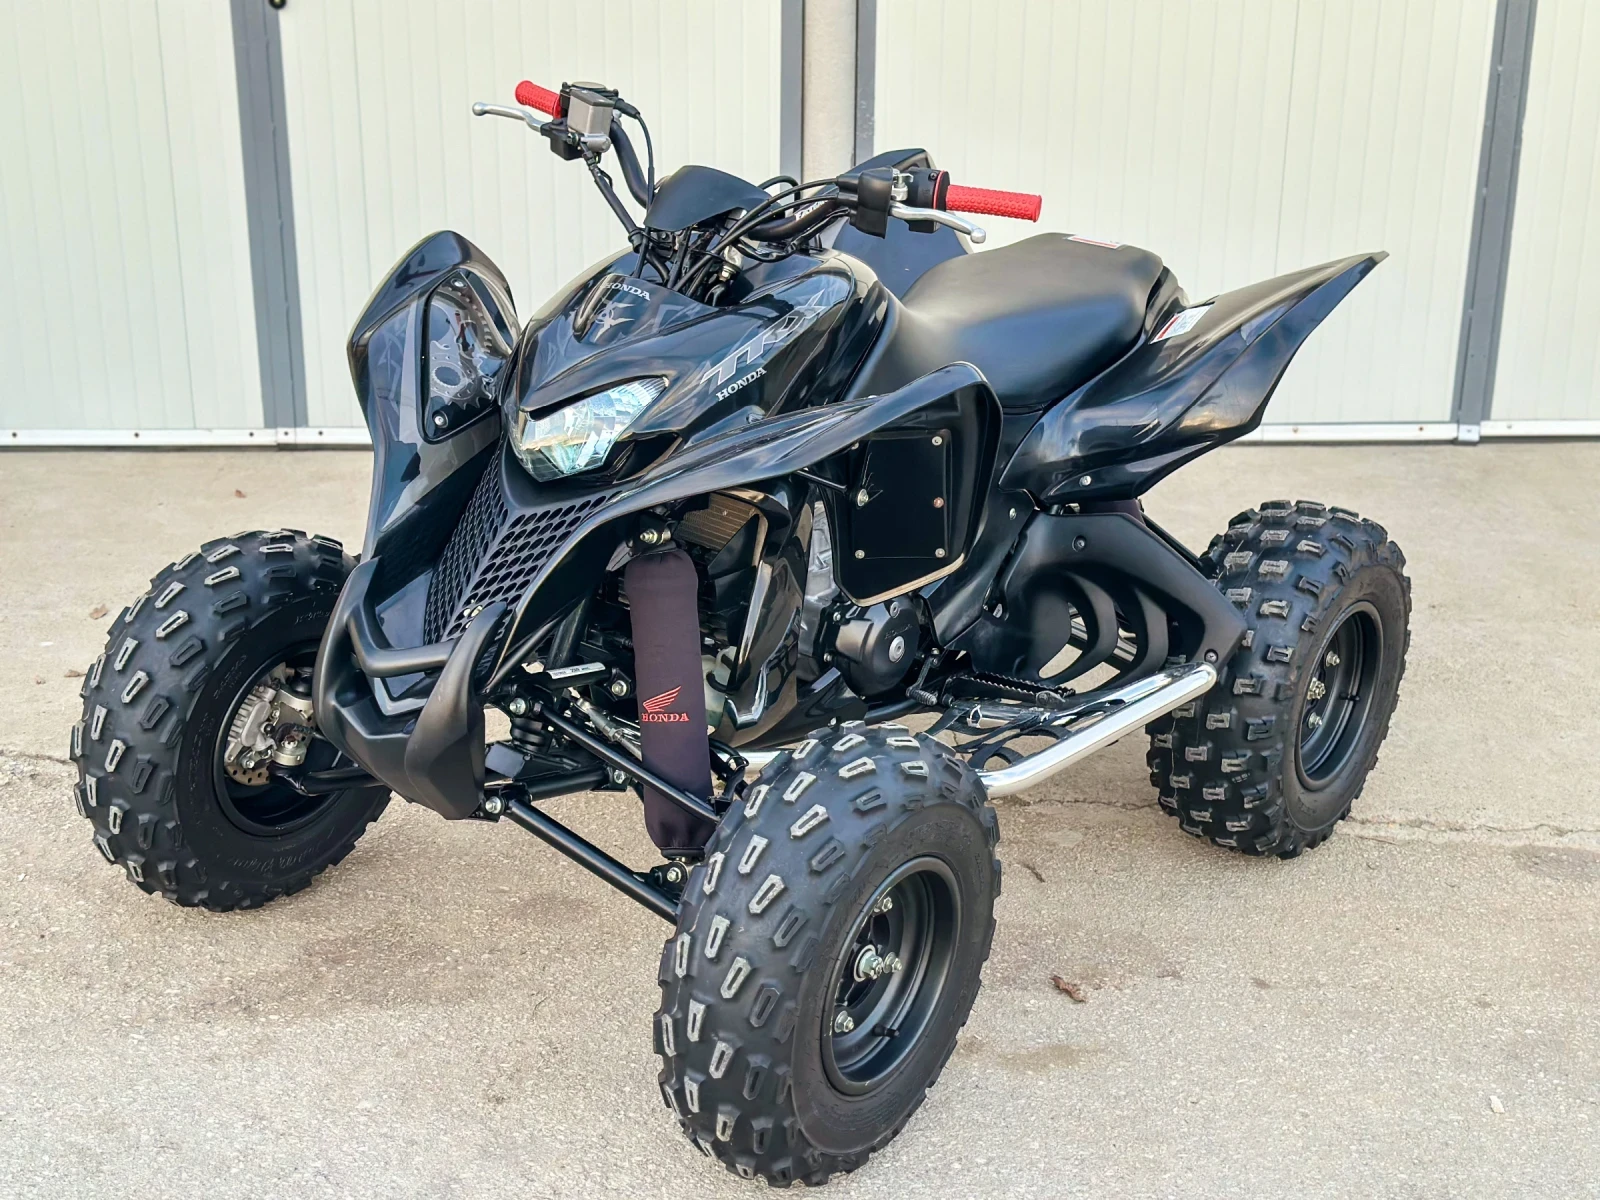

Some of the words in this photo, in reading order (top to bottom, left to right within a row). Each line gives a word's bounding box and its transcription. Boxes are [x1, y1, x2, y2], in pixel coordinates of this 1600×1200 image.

[605, 282, 651, 301] HONDA
[715, 367, 767, 402] HONDA
[641, 712, 690, 723] HONDA
